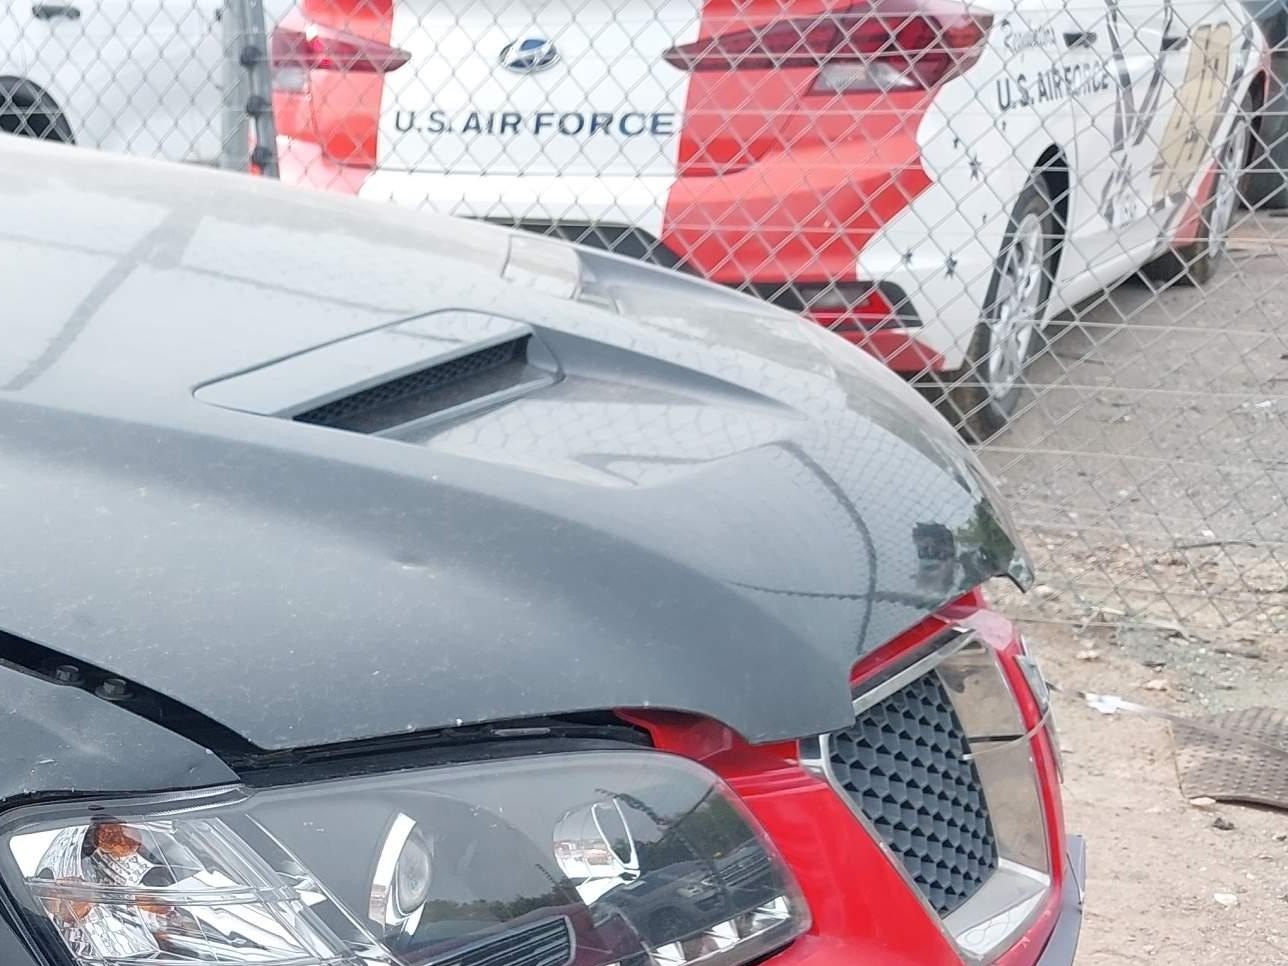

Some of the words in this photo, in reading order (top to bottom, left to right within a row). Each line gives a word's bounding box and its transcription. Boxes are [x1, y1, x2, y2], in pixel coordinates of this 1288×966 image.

[996, 72, 1034, 112] U.S.
[1037, 68, 1064, 104] AIR
[1065, 60, 1110, 97] FORCE
[394, 110, 452, 133] U.S.
[462, 111, 522, 135] AIR
[533, 112, 676, 136] FORCE
